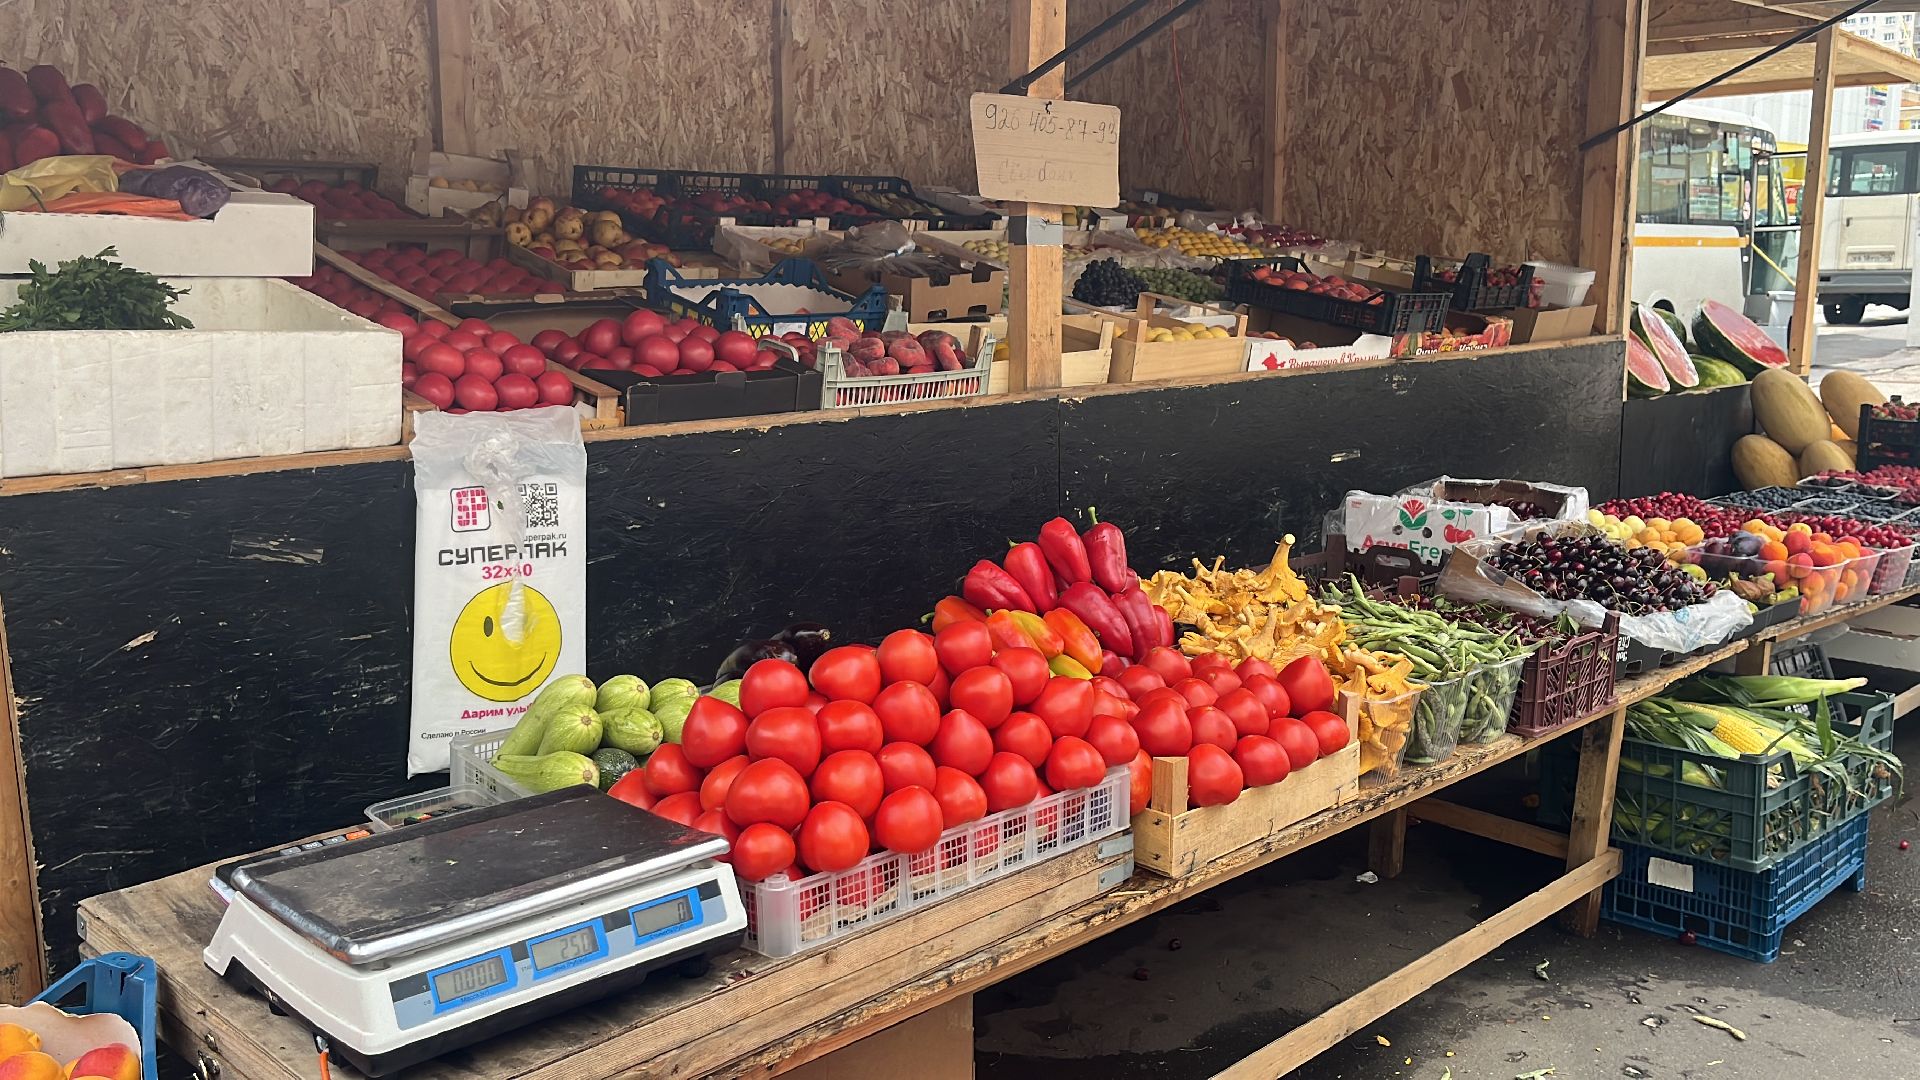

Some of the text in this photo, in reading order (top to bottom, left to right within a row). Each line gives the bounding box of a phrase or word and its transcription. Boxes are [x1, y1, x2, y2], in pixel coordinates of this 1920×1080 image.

[985, 103, 1020, 130] 926
[523, 533, 567, 542] uperpak.ru
[461, 709, 504, 720] Дарим
[421, 732, 453, 740] Сделано
[461, 728, 487, 736] России
